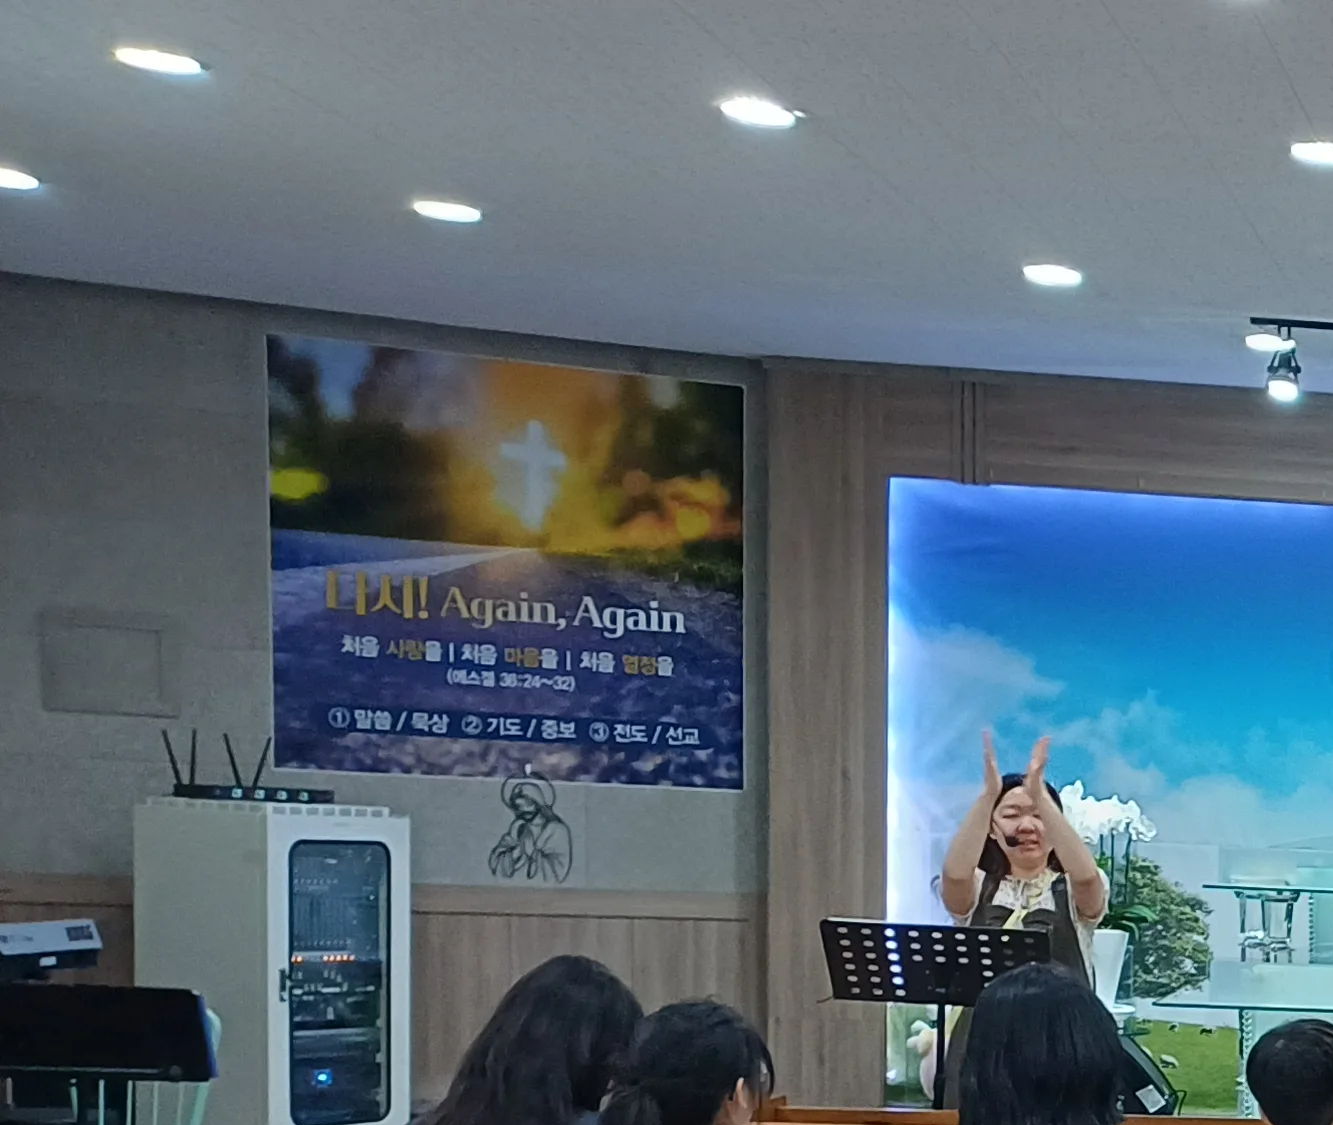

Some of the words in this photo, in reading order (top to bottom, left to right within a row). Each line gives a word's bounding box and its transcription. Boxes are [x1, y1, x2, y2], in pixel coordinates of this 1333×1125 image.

[440, 587, 566, 631] Again,
[574, 596, 686, 639] Again
[461, 643, 497, 666] 처음
[353, 708, 392, 731] 말씀
[410, 713, 450, 734] 묵상
[487, 716, 525, 738] 기도
[541, 719, 576, 740] 중보
[614, 723, 648, 744] 전도
[666, 726, 701, 745] 선교
